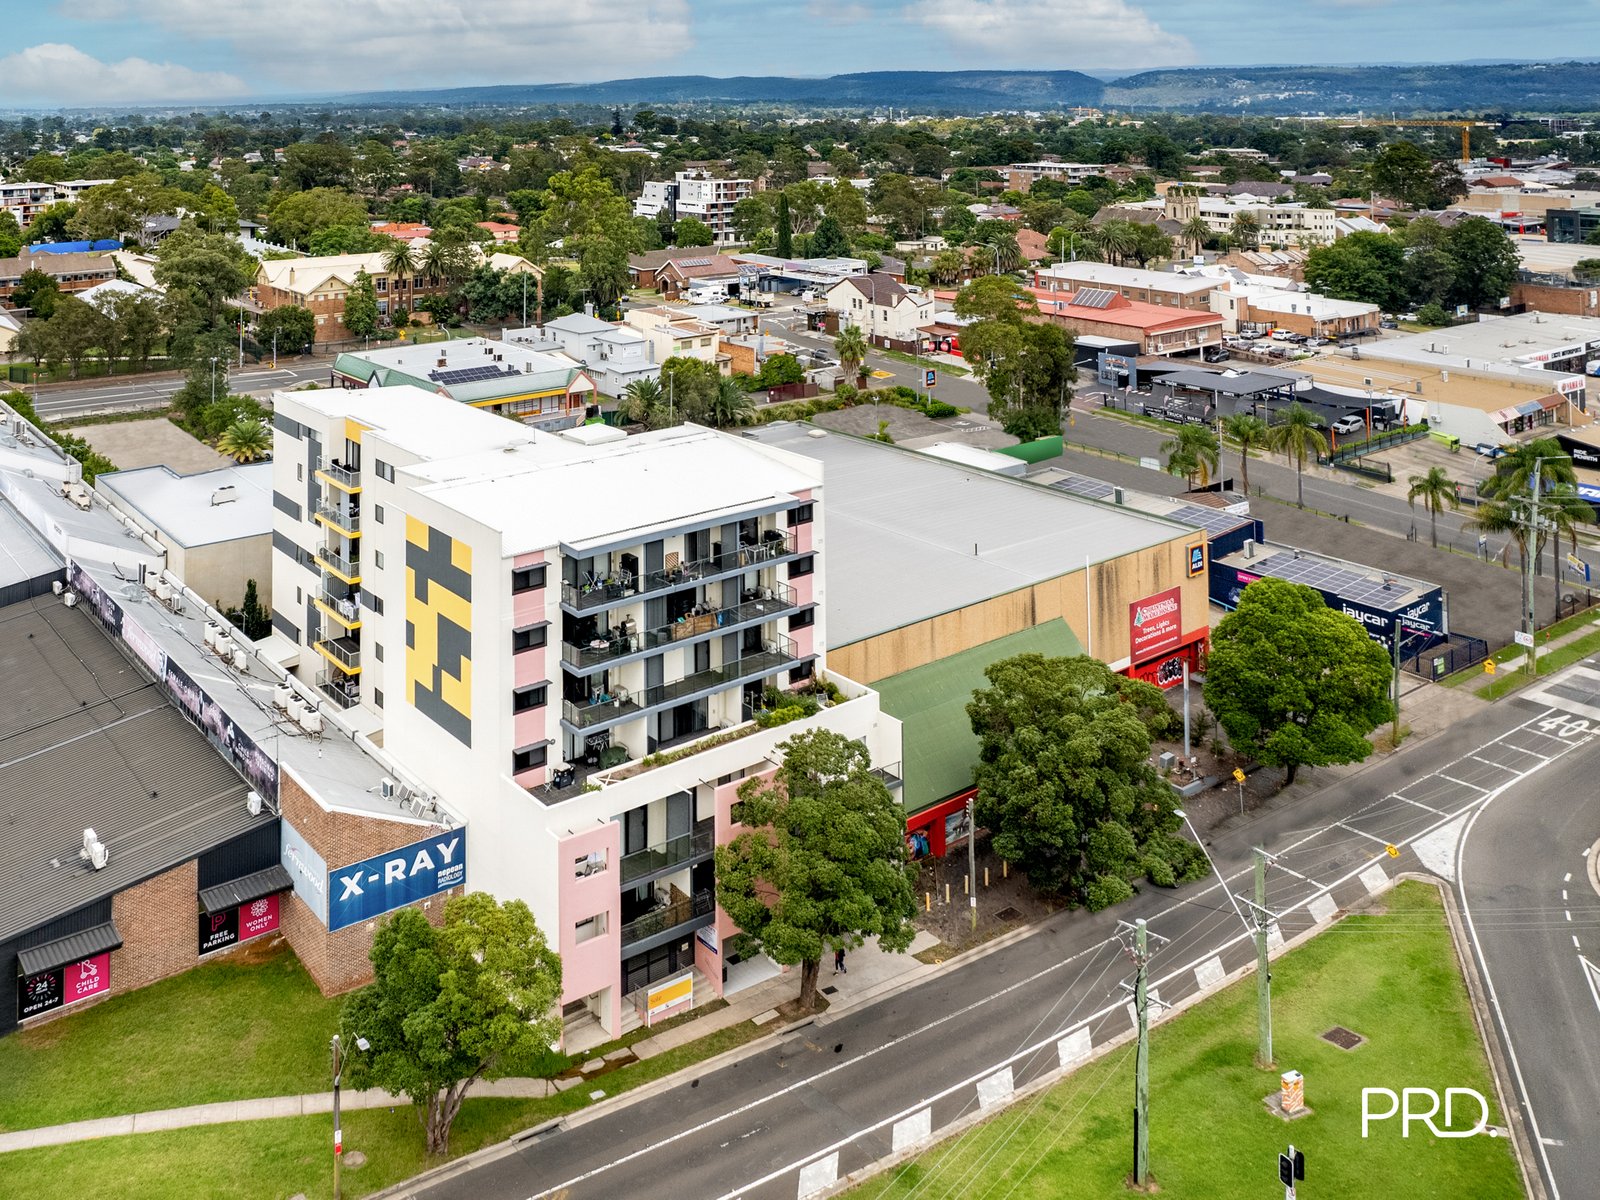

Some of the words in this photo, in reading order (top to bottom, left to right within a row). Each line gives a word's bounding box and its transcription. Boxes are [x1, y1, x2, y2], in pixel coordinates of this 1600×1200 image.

[1342, 603, 1388, 627] jaycar
[1537, 714, 1590, 737] 40
[339, 838, 460, 902] X-RAY
[438, 863, 464, 878] nepean
[438, 871, 464, 884] RADIOLOGY
[246, 914, 272, 928] WOMEN
[250, 922, 268, 932] ONLY
[203, 933, 235, 950] PARKING
[210, 930, 228, 940] FREE
[35, 980, 48, 991] 24
[76, 976, 100, 989] CHILD
[77, 982, 98, 994] CARE
[24, 1002, 42, 1013] OPEN
